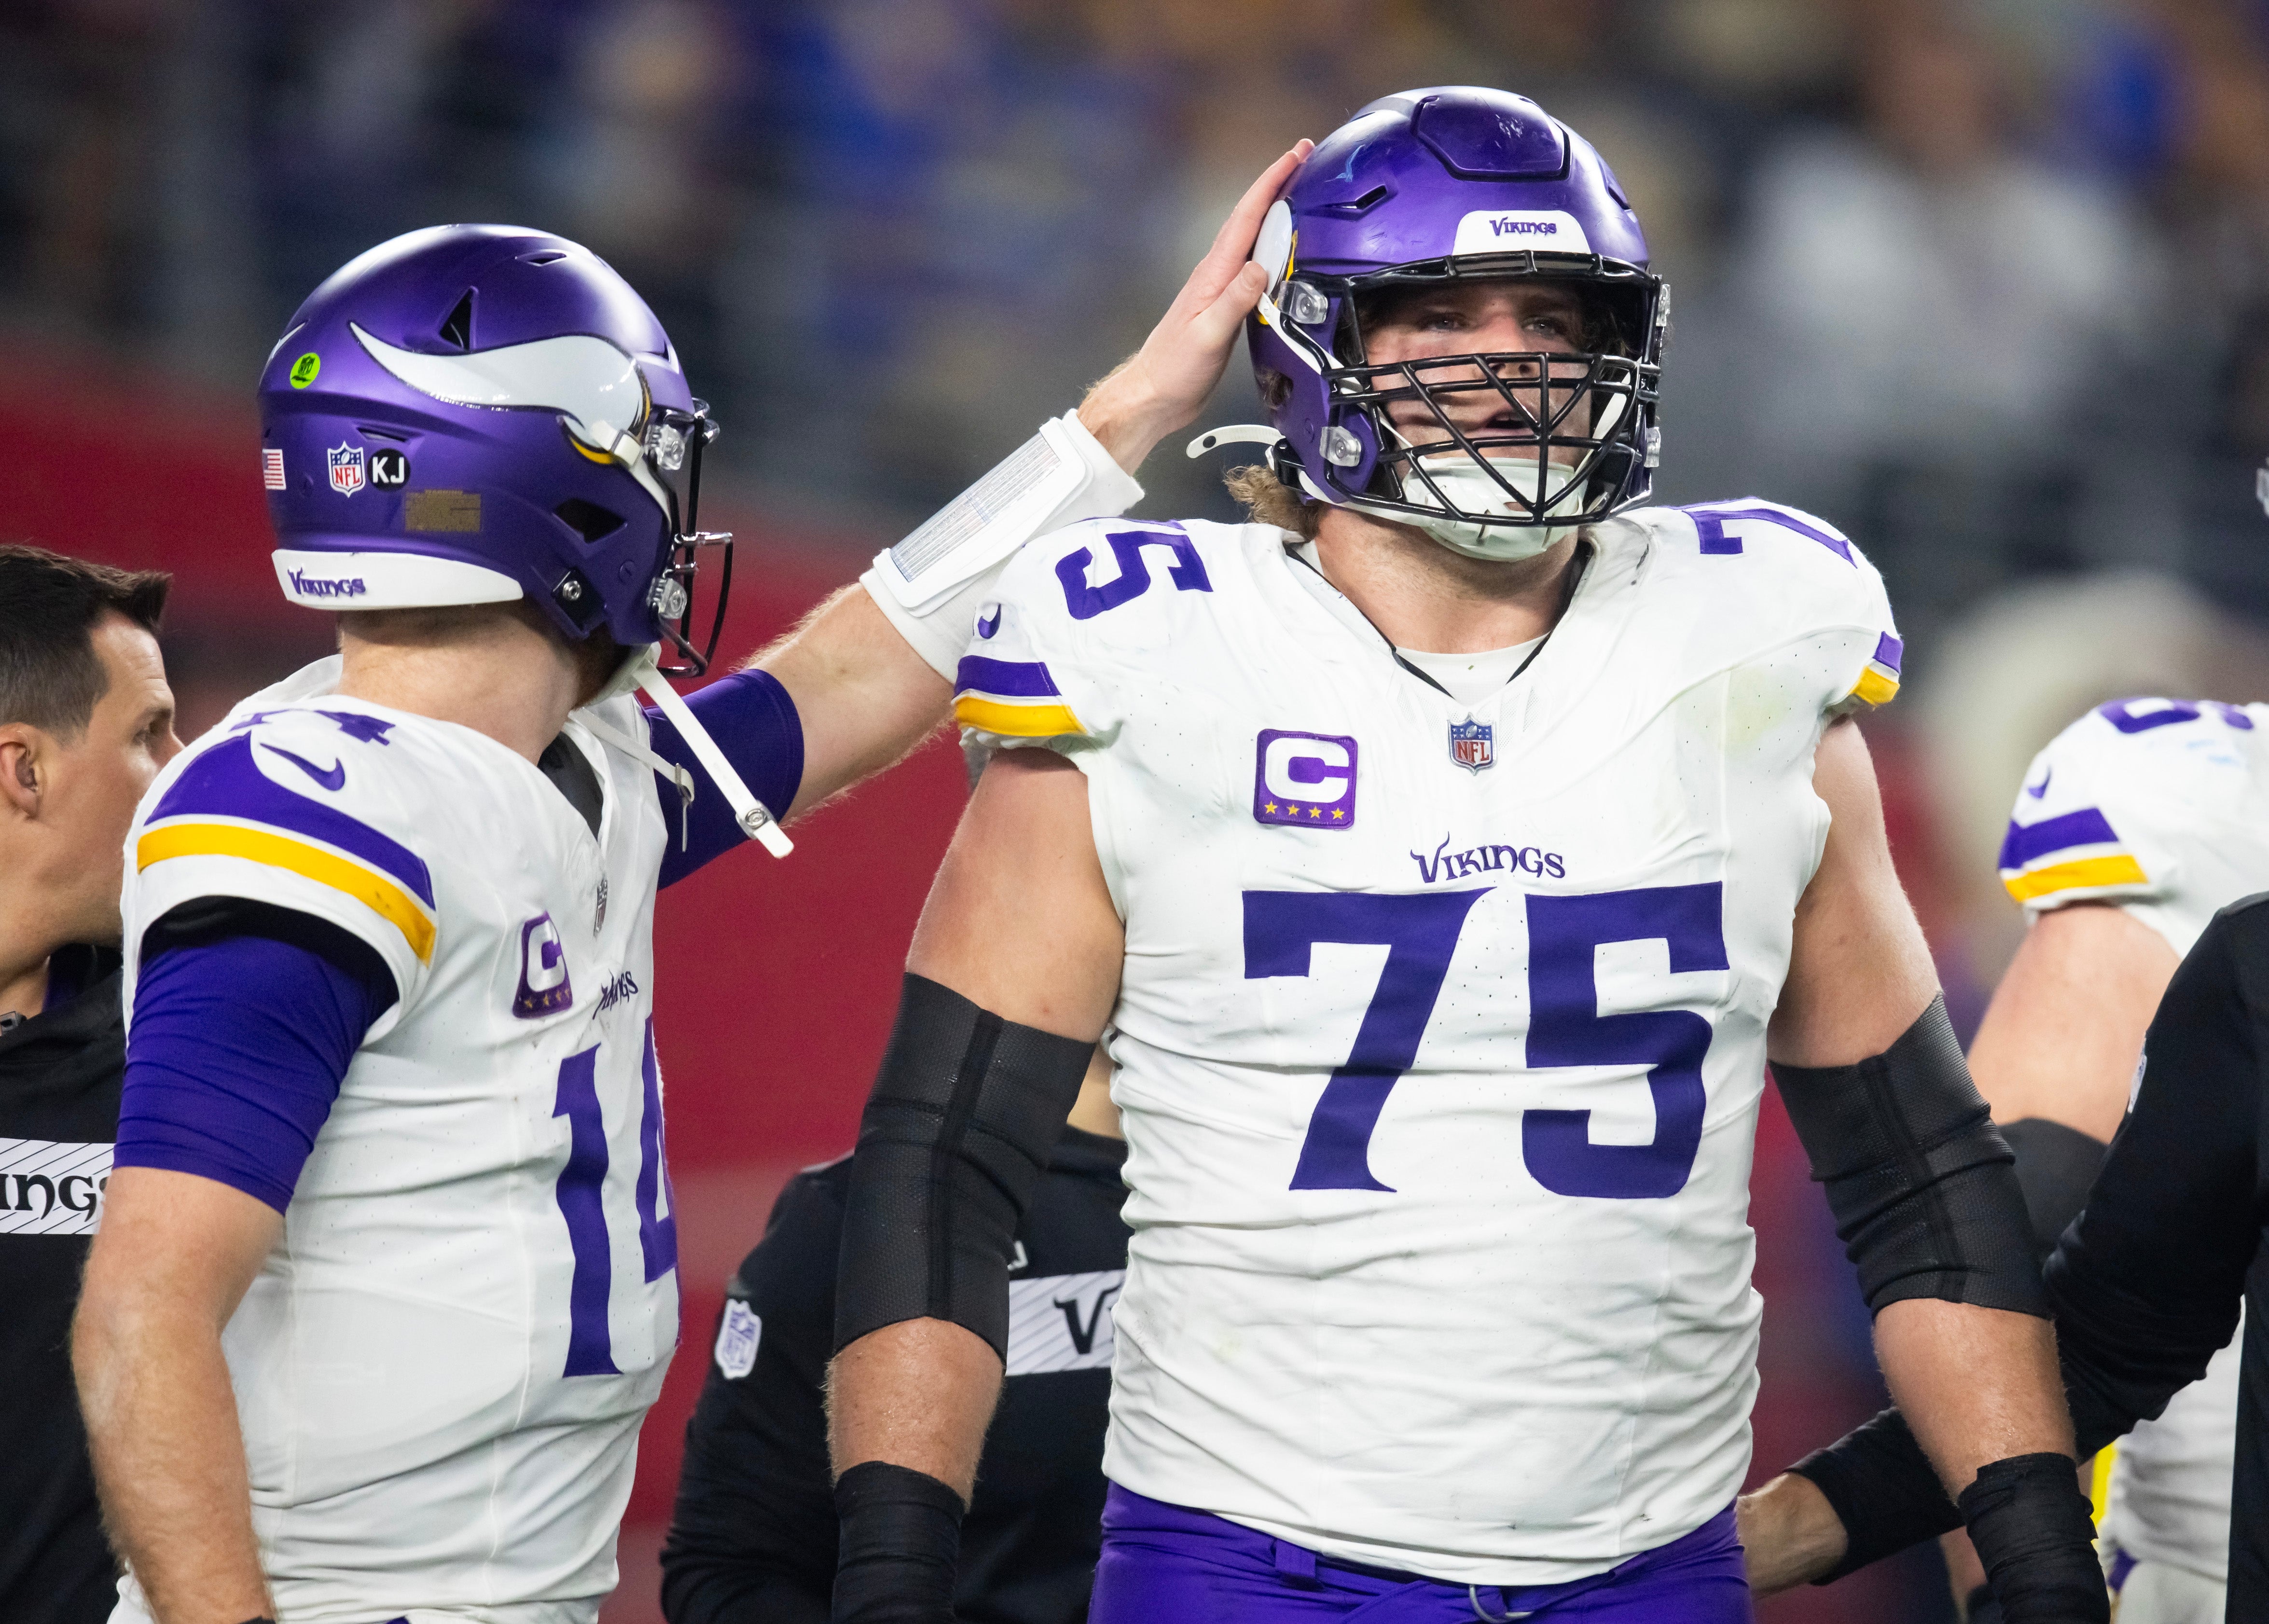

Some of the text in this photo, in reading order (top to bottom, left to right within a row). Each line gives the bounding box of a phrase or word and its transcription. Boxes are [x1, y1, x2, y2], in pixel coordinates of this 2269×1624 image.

[334, 467, 360, 486] NFL
[372, 456, 405, 484] KJ
[1264, 736, 1350, 804] C
[1454, 738, 1491, 765] NFL
[525, 916, 567, 994] C
[1241, 881, 1730, 1199] 75
